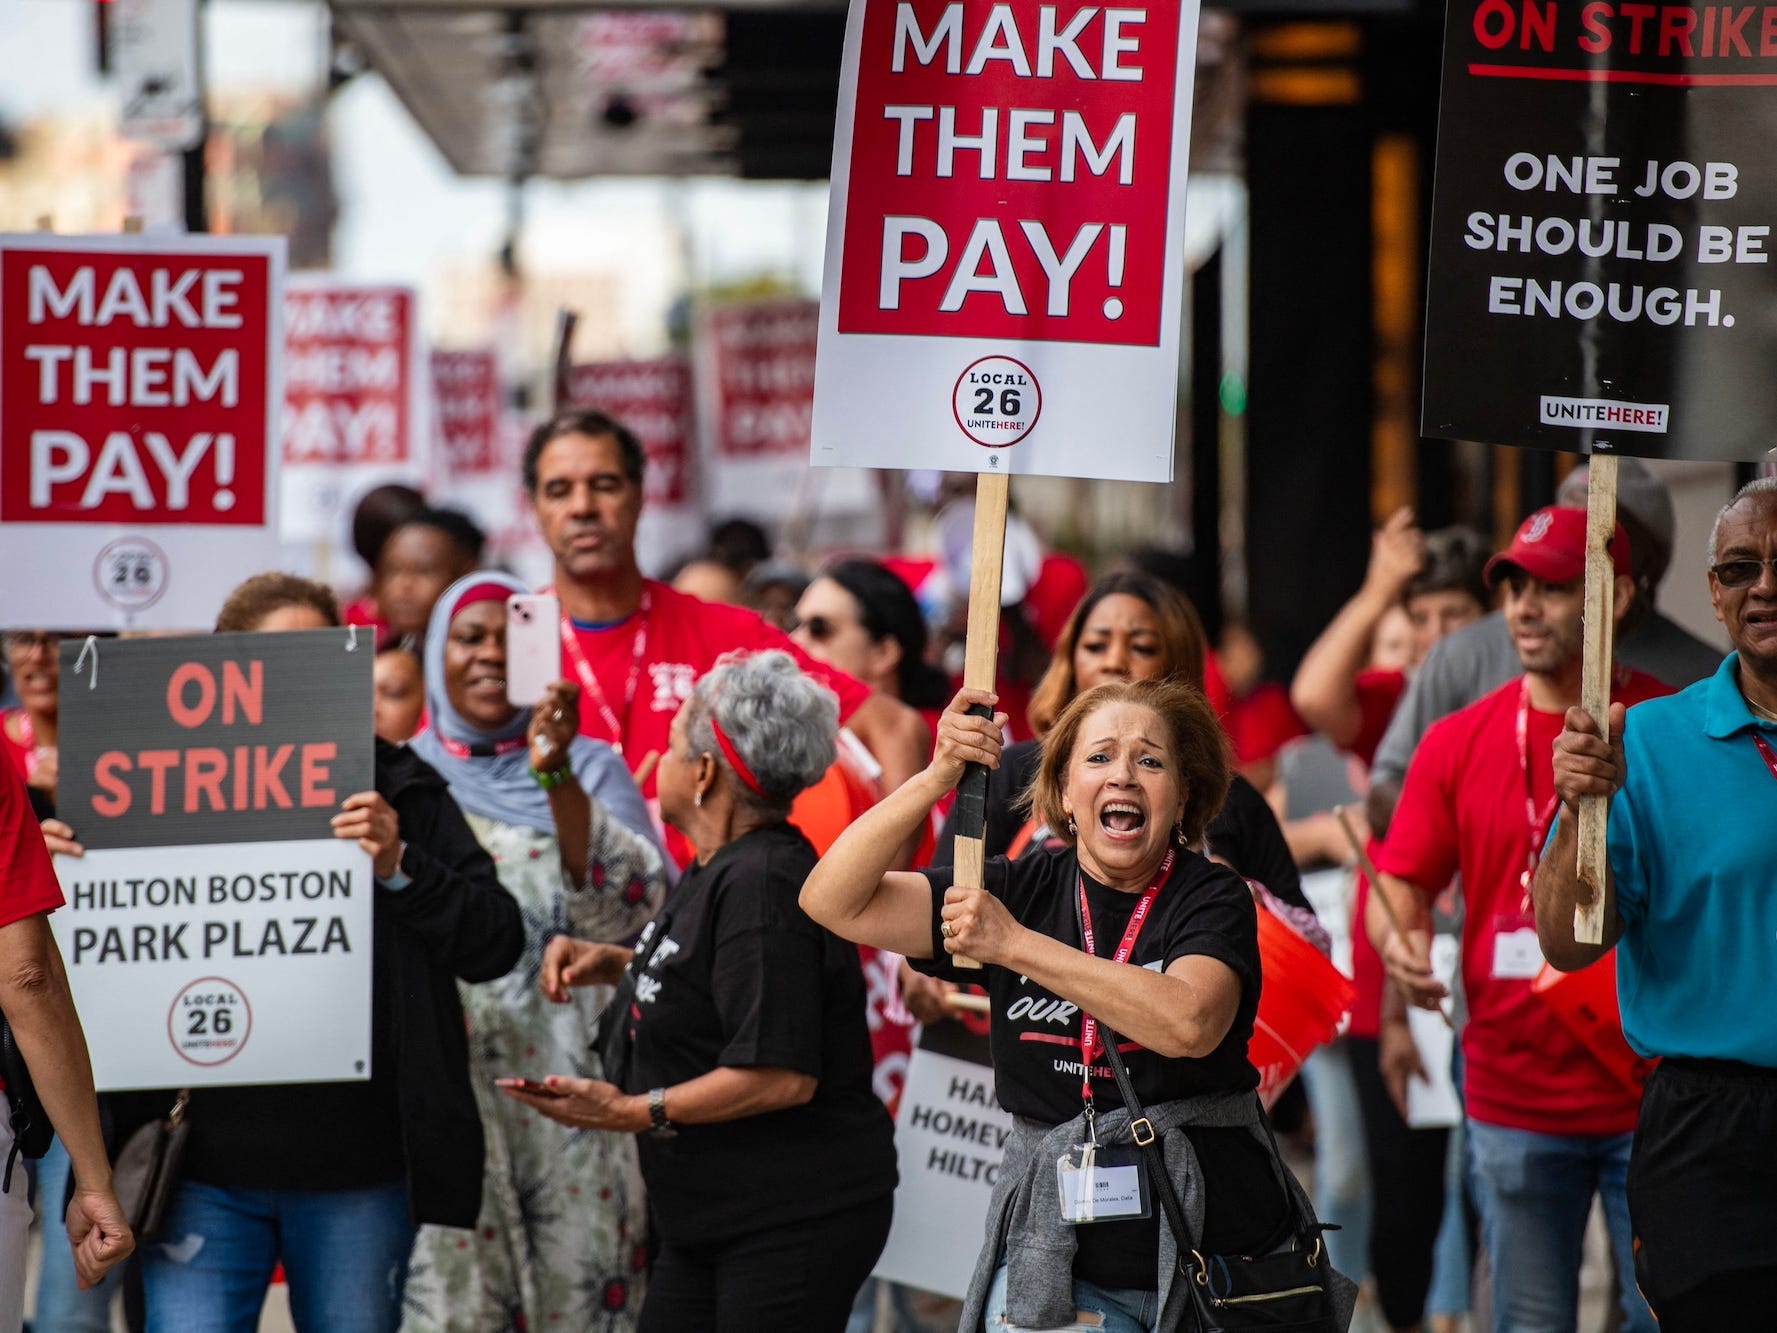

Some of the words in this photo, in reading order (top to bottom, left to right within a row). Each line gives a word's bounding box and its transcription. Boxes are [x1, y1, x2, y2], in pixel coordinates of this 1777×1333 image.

[891, 2, 1147, 82] MAKE
[1472, 0, 1558, 52] ON
[1577, 2, 1777, 57] STRIKE
[884, 104, 1137, 186] THEM
[1504, 152, 1620, 195] ONE
[1634, 160, 1739, 200] JOB
[1464, 211, 1684, 262] SHOULD
[1697, 225, 1770, 264] BE
[878, 215, 1127, 321] PAY!
[28, 265, 244, 328] MAKE
[1488, 276, 1736, 328] ENOUGH.
[25, 345, 240, 407] THEM
[970, 373, 1027, 386] LOCAL
[967, 419, 1025, 431] UNITEHERE!
[973, 388, 1021, 416] 26
[1546, 402, 1663, 426] UNITEHERE!
[29, 429, 236, 512] PAY!
[166, 660, 264, 729] ON
[91, 742, 338, 818] STRIKE
[73, 877, 197, 912] HILTON
[208, 870, 352, 904] BOSTON
[73, 923, 189, 965] PARK
[203, 916, 352, 959] PLAZA
[183, 993, 237, 1006] LOCAL
[188, 1008, 232, 1036] 26
[1007, 996, 1079, 1026] OUR
[1053, 1060, 1131, 1079] UNITHE!
